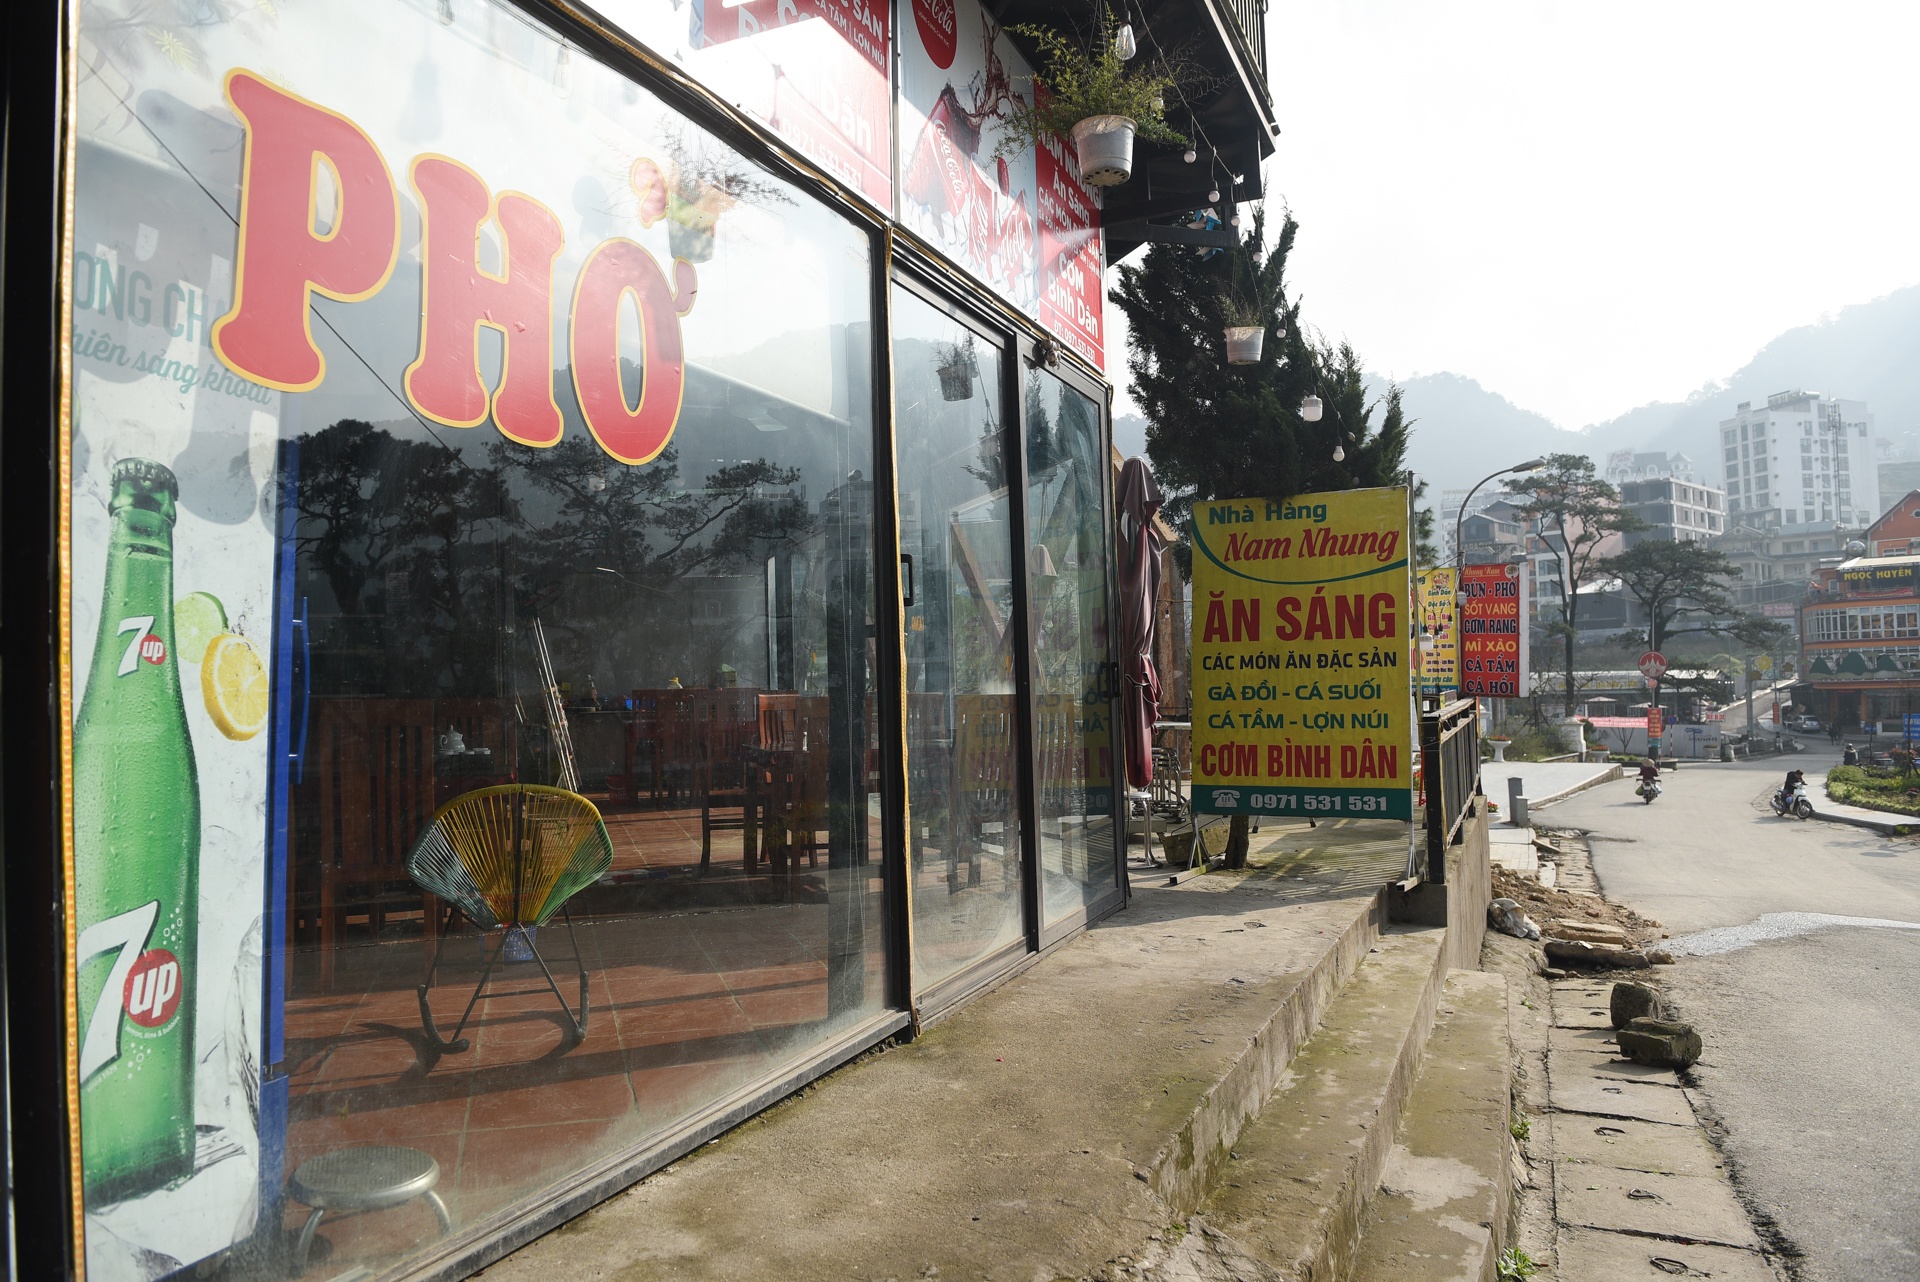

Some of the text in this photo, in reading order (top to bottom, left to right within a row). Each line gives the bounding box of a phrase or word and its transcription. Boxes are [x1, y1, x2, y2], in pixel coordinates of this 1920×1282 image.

[1038, 184, 1055, 215] CÁC
[1053, 165, 1067, 202] Ăn
[1067, 187, 1090, 230] Sáng
[211, 66, 698, 466] PHỞ
[1059, 252, 1085, 297] CƠM
[1047, 270, 1099, 339] Bình Dân
[1209, 501, 1327, 525] Nhà Hàng
[1224, 527, 1400, 562] Nam Nhung
[1464, 578, 1486, 598] BÚN
[1494, 575, 1518, 598] PHỞ
[1202, 586, 1397, 644] ĂN SÁNG
[1464, 600, 1517, 615] SỐT VANG
[1464, 618, 1517, 634] CƠM RANG
[1465, 638, 1482, 652] MÌ
[1486, 638, 1517, 652] XÀO
[1202, 652, 1234, 671] CÁC
[1239, 651, 1281, 670] MÓN
[1284, 651, 1312, 670] ĂN
[1316, 650, 1353, 672] ĐẶC
[1358, 647, 1398, 668] SẢN
[1465, 653, 1516, 673] CÁ TẦM
[1208, 682, 1237, 701] GÀ
[1240, 680, 1277, 700] ĐỒI
[1295, 680, 1325, 700] CÁ
[1328, 677, 1381, 700] SUỐI
[1466, 675, 1515, 695] CÁ HỒI
[1208, 710, 1236, 730] CÁ
[1238, 708, 1285, 730] TẦM
[1302, 711, 1345, 733] LỢN
[1351, 710, 1390, 730] NÚI
[1201, 738, 1397, 779] CƠM BÌNH DÂN
[1250, 793, 1387, 811] 0971 531 531
